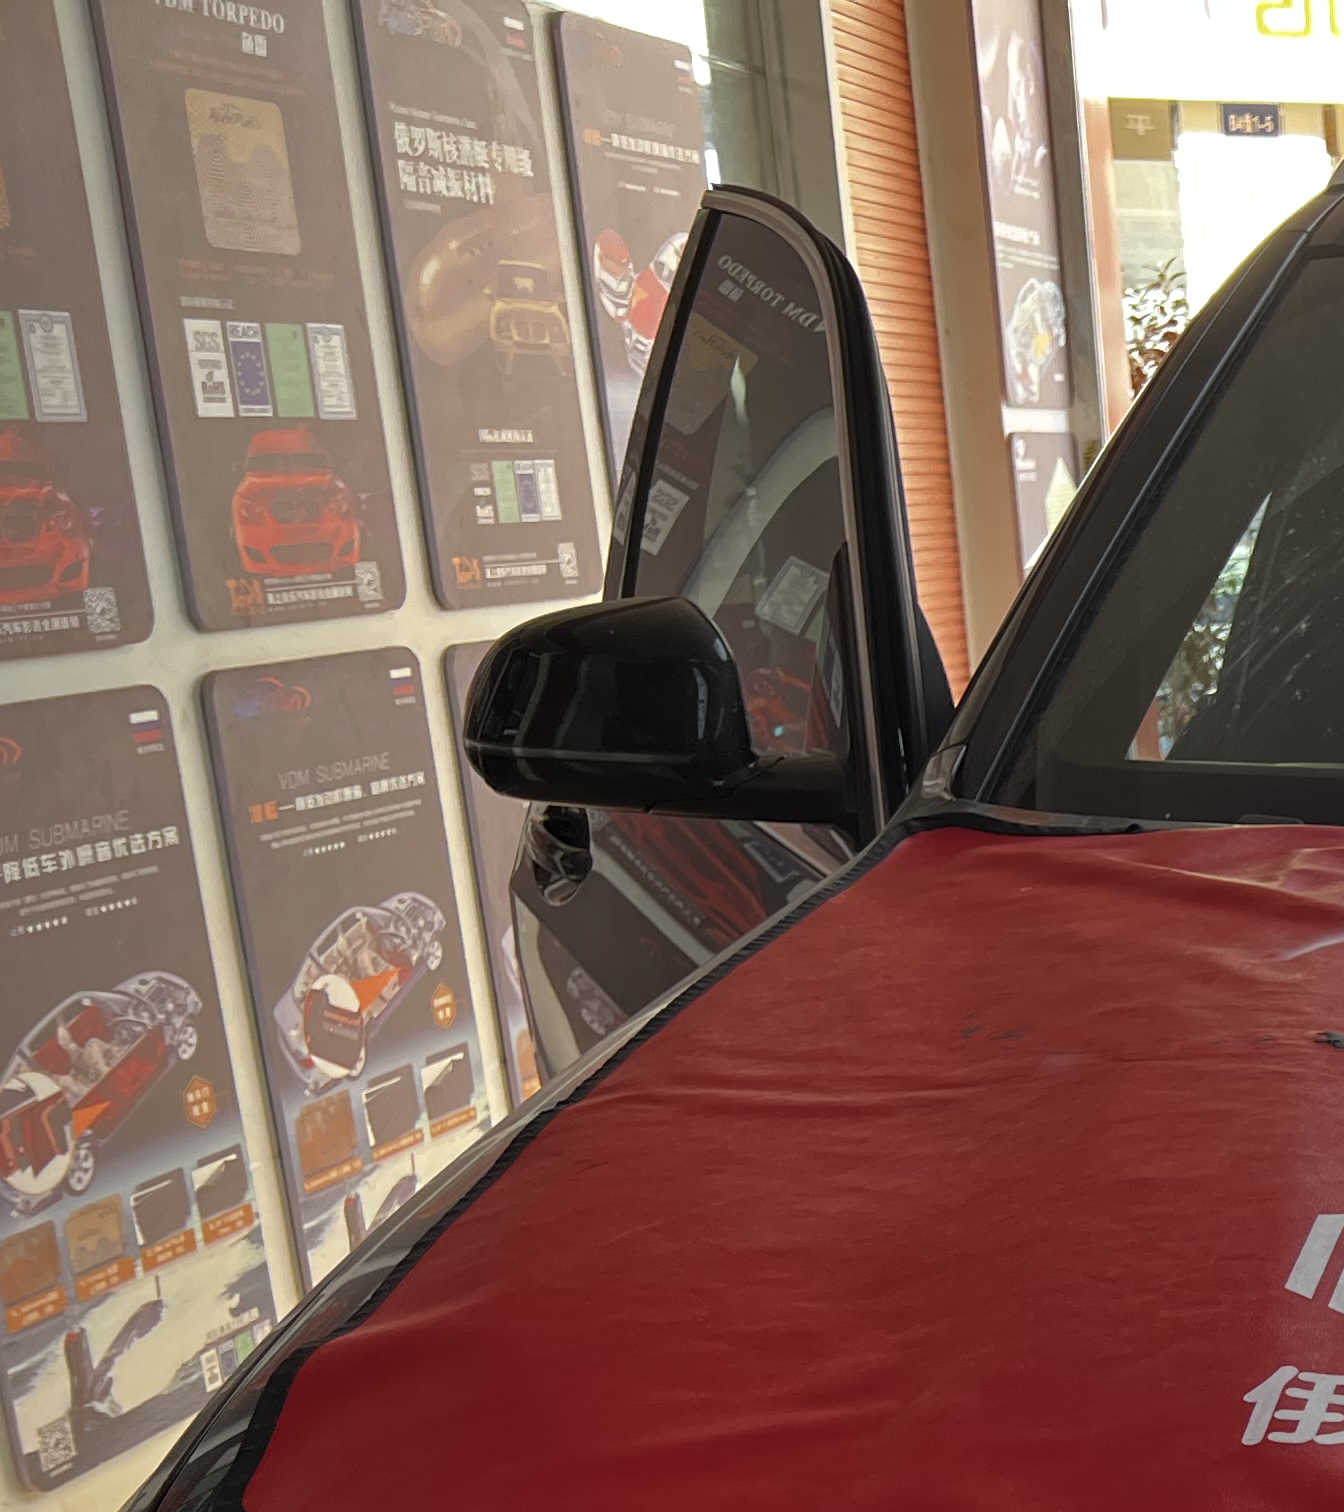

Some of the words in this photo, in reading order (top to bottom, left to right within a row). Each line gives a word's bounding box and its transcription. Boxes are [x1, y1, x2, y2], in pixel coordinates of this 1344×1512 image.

[202, 0, 286, 34] TORPEDO
[315, 751, 391, 784] SUBMARINE
[28, 809, 131, 851] SUBMARINE
